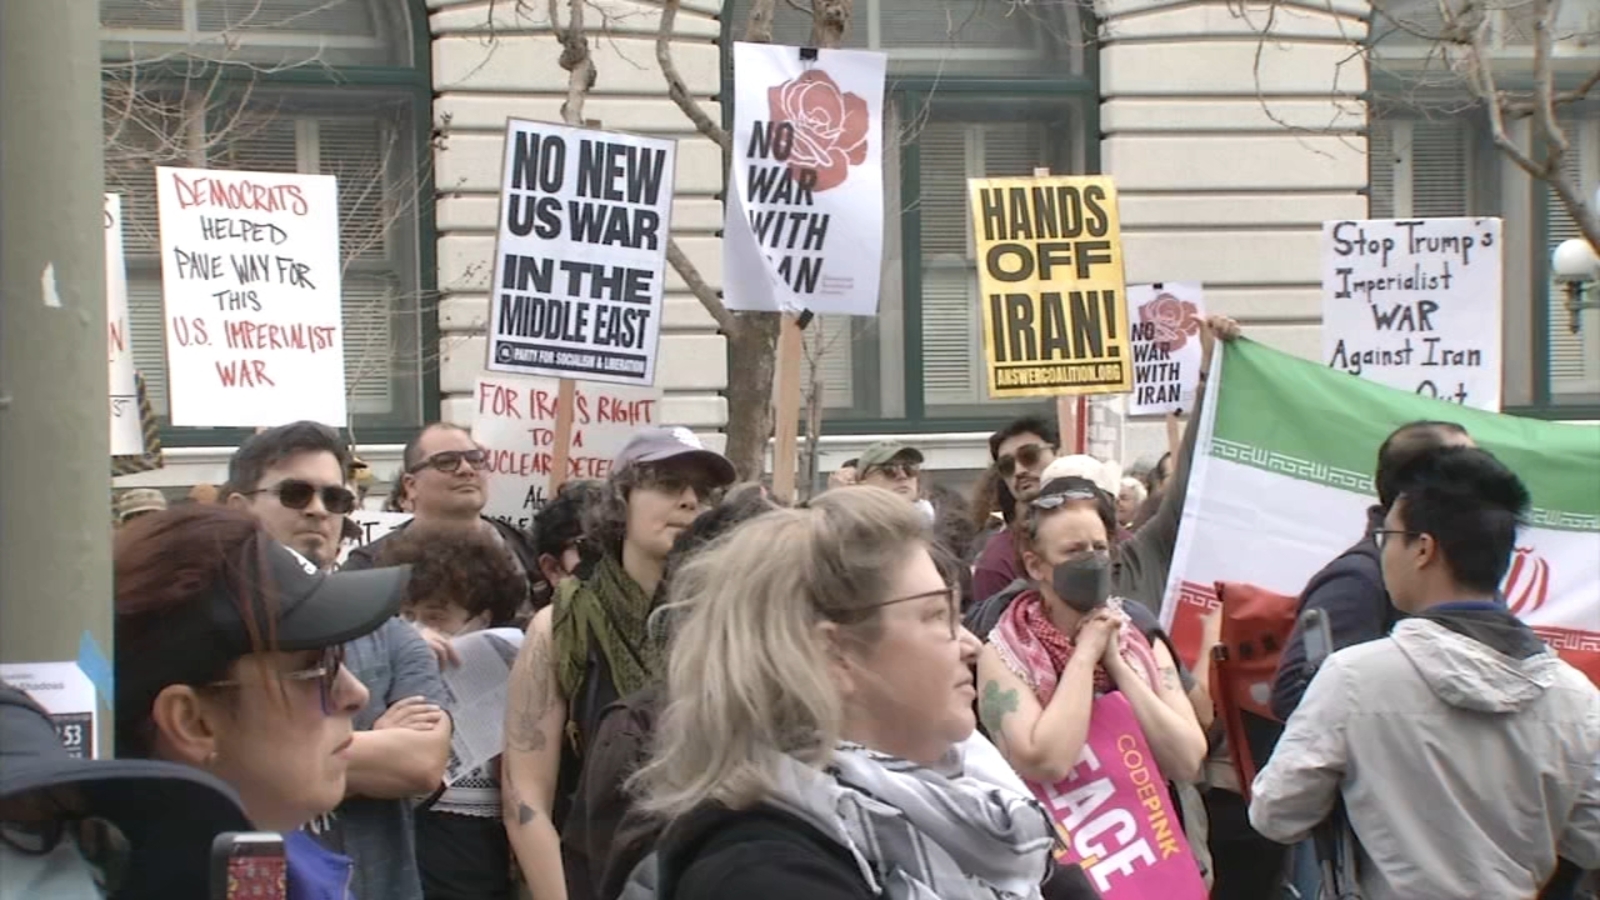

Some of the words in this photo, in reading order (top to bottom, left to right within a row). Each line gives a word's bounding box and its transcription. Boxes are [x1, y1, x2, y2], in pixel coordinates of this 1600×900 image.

[747, 120, 794, 161] NO
[511, 131, 566, 194] NO
[576, 139, 666, 206] NEW
[747, 165, 818, 206] WAR
[173, 172, 308, 216] DEMOCRATS
[979, 185, 1109, 240] HANDS
[200, 214, 288, 245] HELPED
[507, 194, 563, 239] US
[568, 200, 660, 251] WAR
[748, 209, 830, 251] WITH
[986, 241, 1113, 282] OFF
[1333, 221, 1394, 267] Stop
[1395, 220, 1493, 266] Trump's
[174, 246, 225, 282] PAVE
[230, 253, 269, 285] WAY
[276, 256, 316, 290] FOR
[503, 254, 554, 294] IN
[560, 260, 654, 305] THE
[766, 255, 823, 293] AN
[1335, 261, 1453, 303] Imperialist
[212, 290, 262, 312] THIS
[499, 294, 590, 343] MIDDLE
[593, 303, 650, 349] EAST
[1372, 300, 1439, 332] WAR
[173, 316, 212, 347] U.S.
[224, 319, 336, 353] IMPERIALIST
[989, 290, 1120, 362] IRAN!
[1131, 321, 1155, 342] NO
[1133, 342, 1171, 362] WAR
[1330, 338, 1414, 376] Against
[1420, 337, 1481, 367] Iran
[215, 359, 275, 388] WAR
[997, 364, 1121, 386] ANSWERCOALITION.ORG
[1135, 362, 1180, 384] WITH
[479, 382, 521, 420] FOR
[597, 396, 656, 426] RIGHT
[1137, 384, 1181, 405] IRAN
[528, 428, 553, 446] TO
[572, 430, 583, 447] A
[484, 450, 552, 476] UCLEAR
[1117, 734, 1180, 860] CODEPINK
[1041, 743, 1157, 893] EACE
